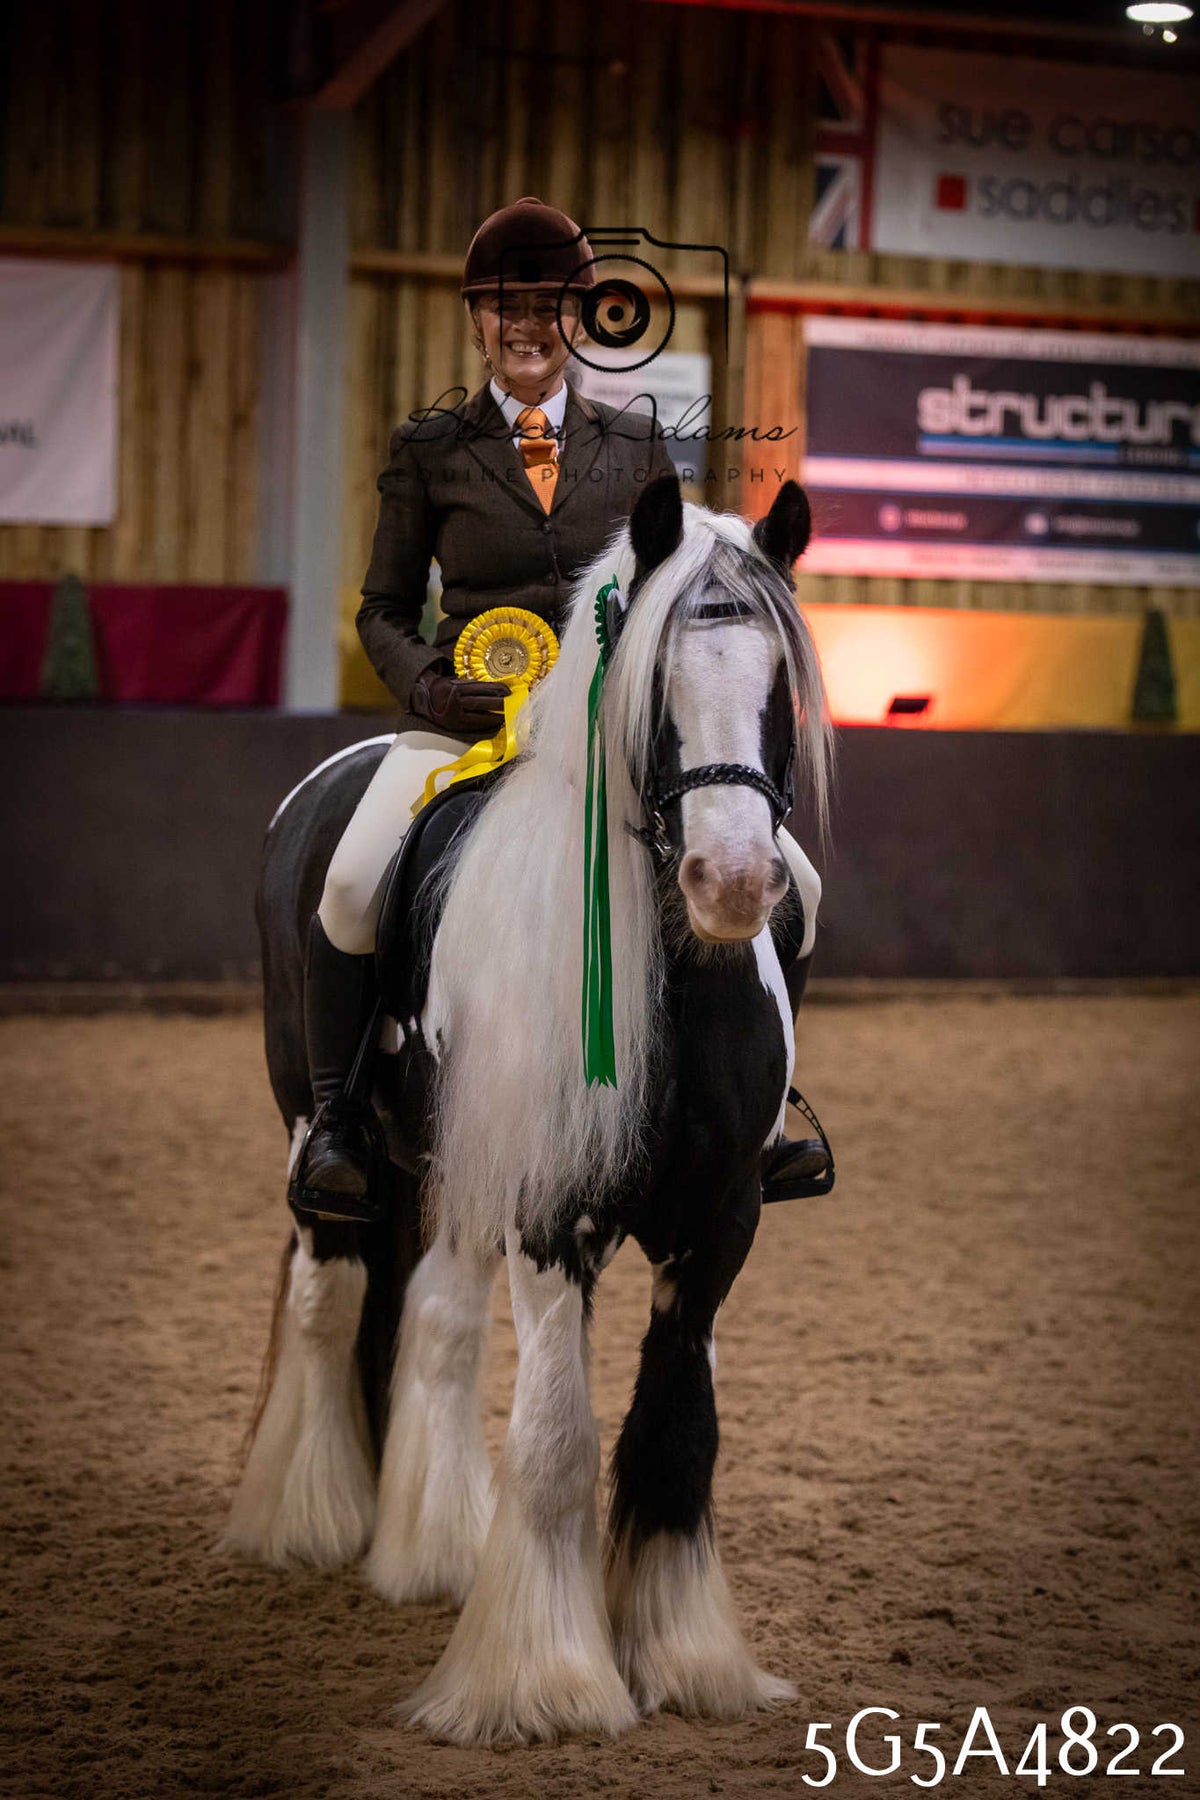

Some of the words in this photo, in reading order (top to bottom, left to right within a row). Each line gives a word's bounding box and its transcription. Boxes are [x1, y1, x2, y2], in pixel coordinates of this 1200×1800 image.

[937, 101, 1034, 151] sue
[977, 171, 1189, 236] saddles
[917, 373, 1200, 444] structur
